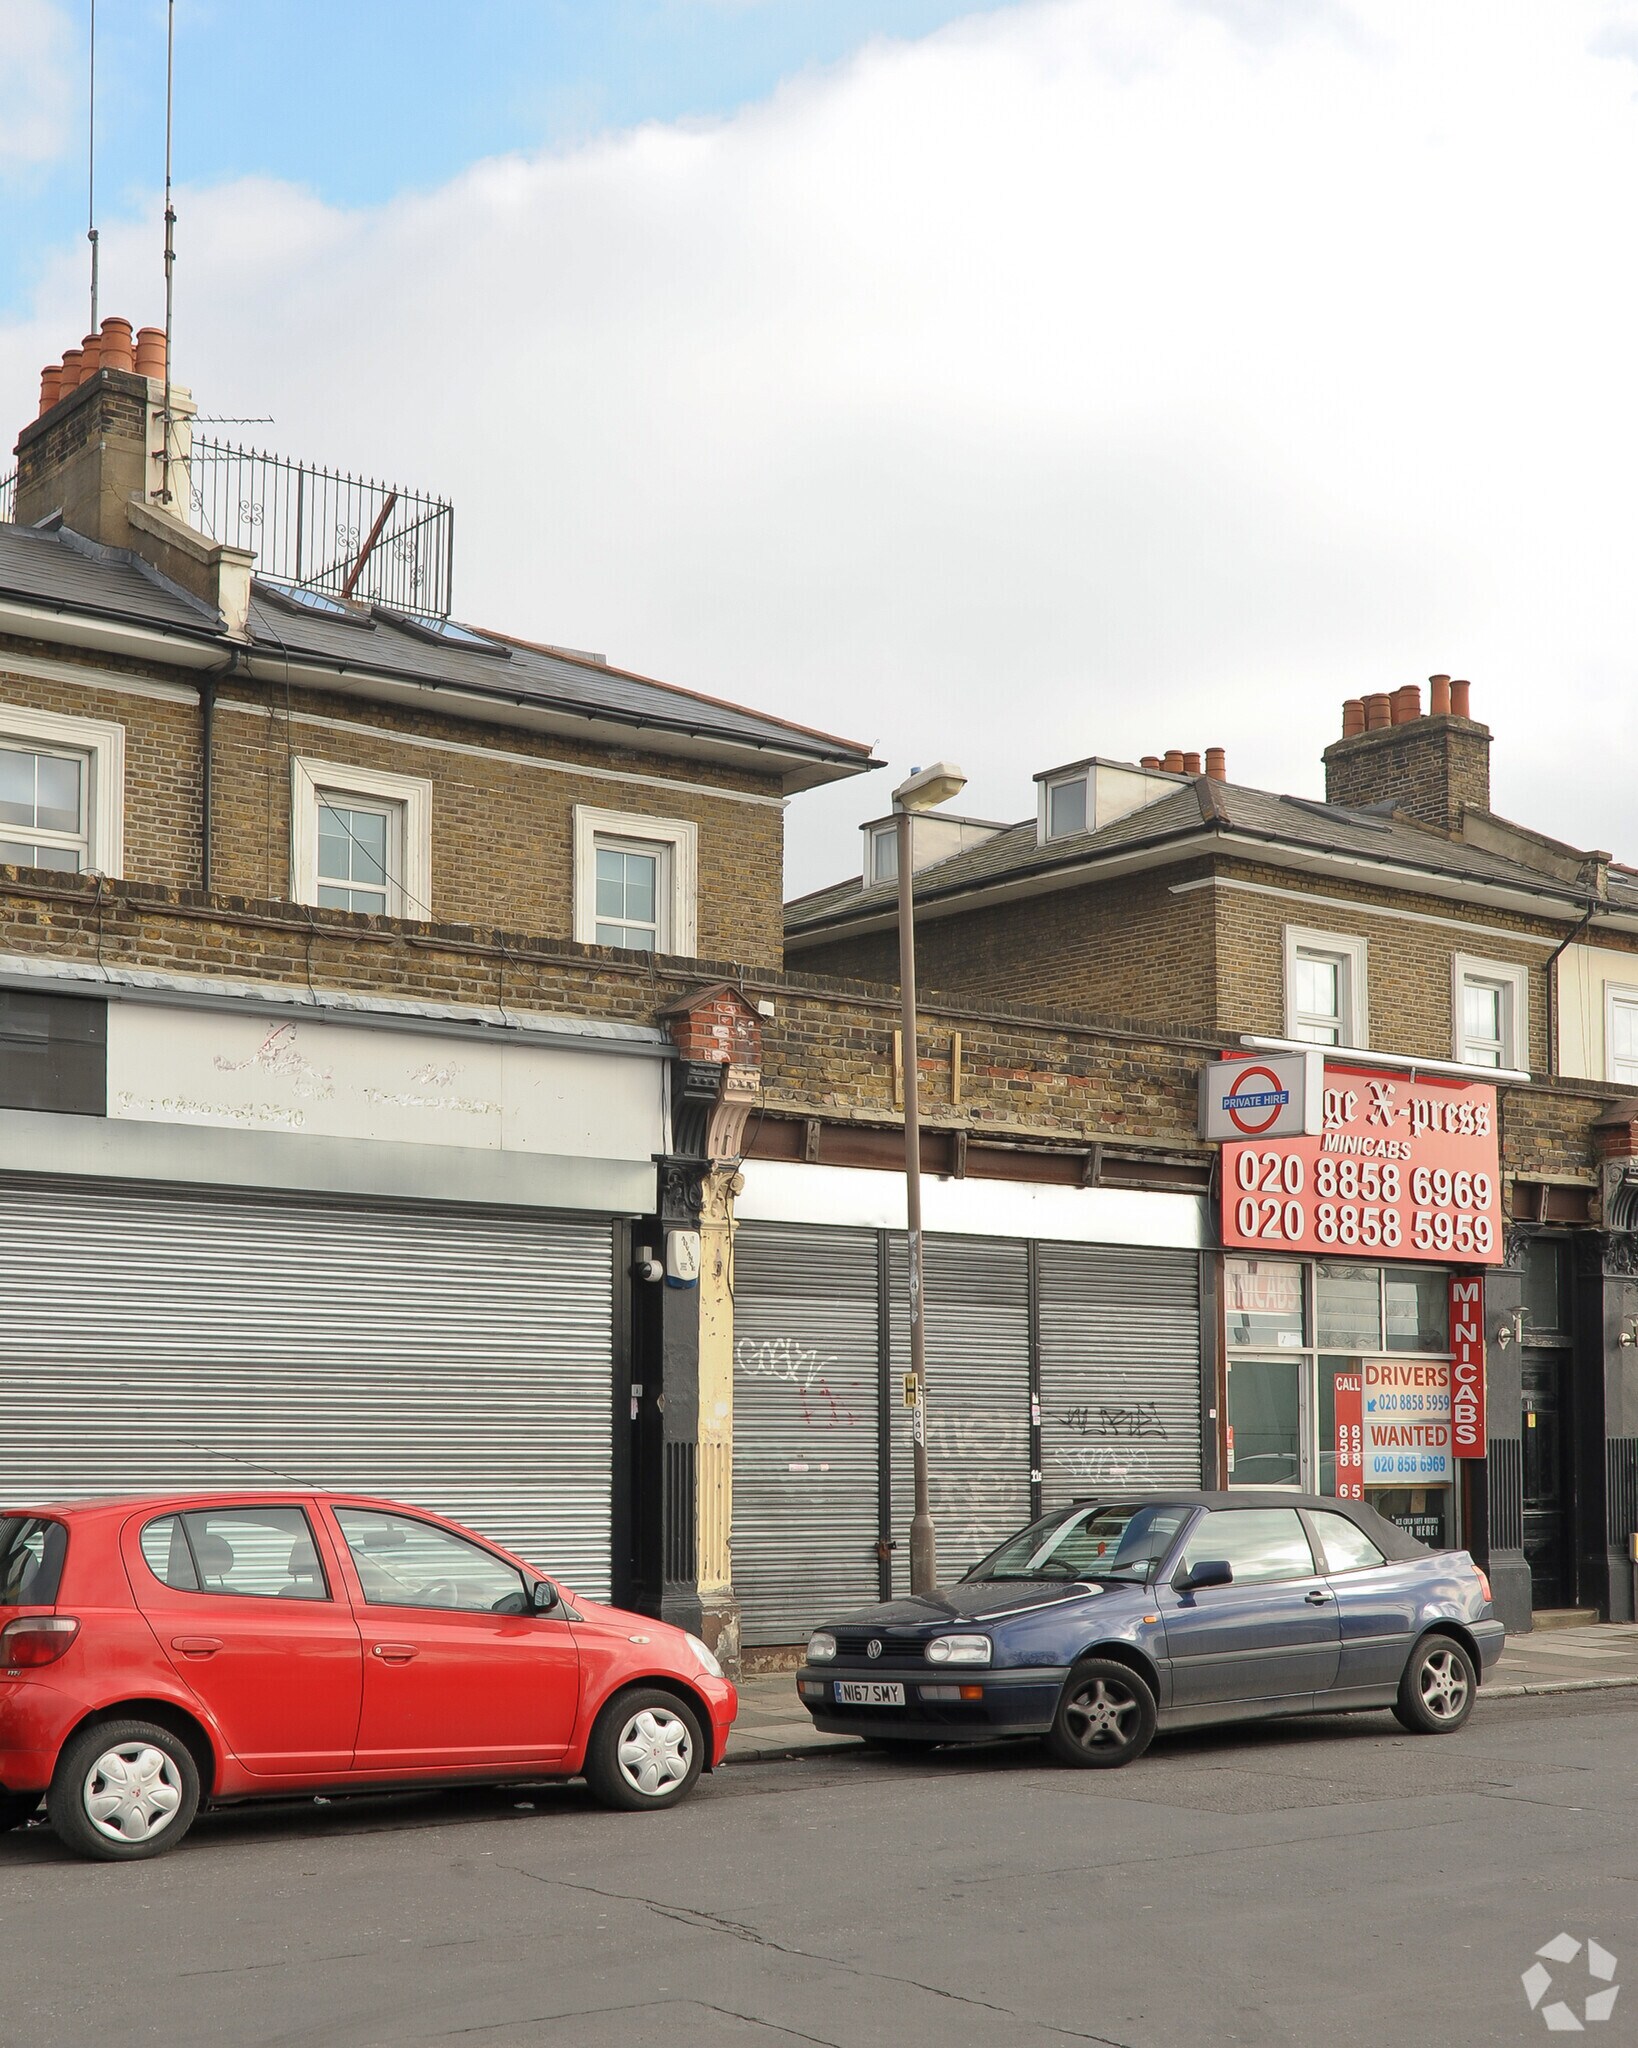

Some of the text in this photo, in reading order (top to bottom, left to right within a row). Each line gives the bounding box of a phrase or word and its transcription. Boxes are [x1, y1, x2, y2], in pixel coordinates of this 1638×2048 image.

[1223, 1093, 1286, 1109] PRIVATE HIRE
[1365, 1081, 1492, 1138] X-press
[1321, 1133, 1412, 1160] MINICABS
[1237, 1150, 1493, 1211] 020 8858 6969
[1237, 1196, 1494, 1254] 020 8858 5959
[1452, 1283, 1479, 1445] MINICABS
[1336, 1377, 1361, 1391] CALL
[1365, 1365, 1449, 1387] DRIVERS
[1379, 1393, 1450, 1411] 020 8858 5959
[1370, 1425, 1448, 1447] WANTED
[1373, 1456, 1446, 1473] 020 858 6969
[1416, 1525, 1438, 1536] HERE!
[843, 1684, 898, 1702] N167 SMY
